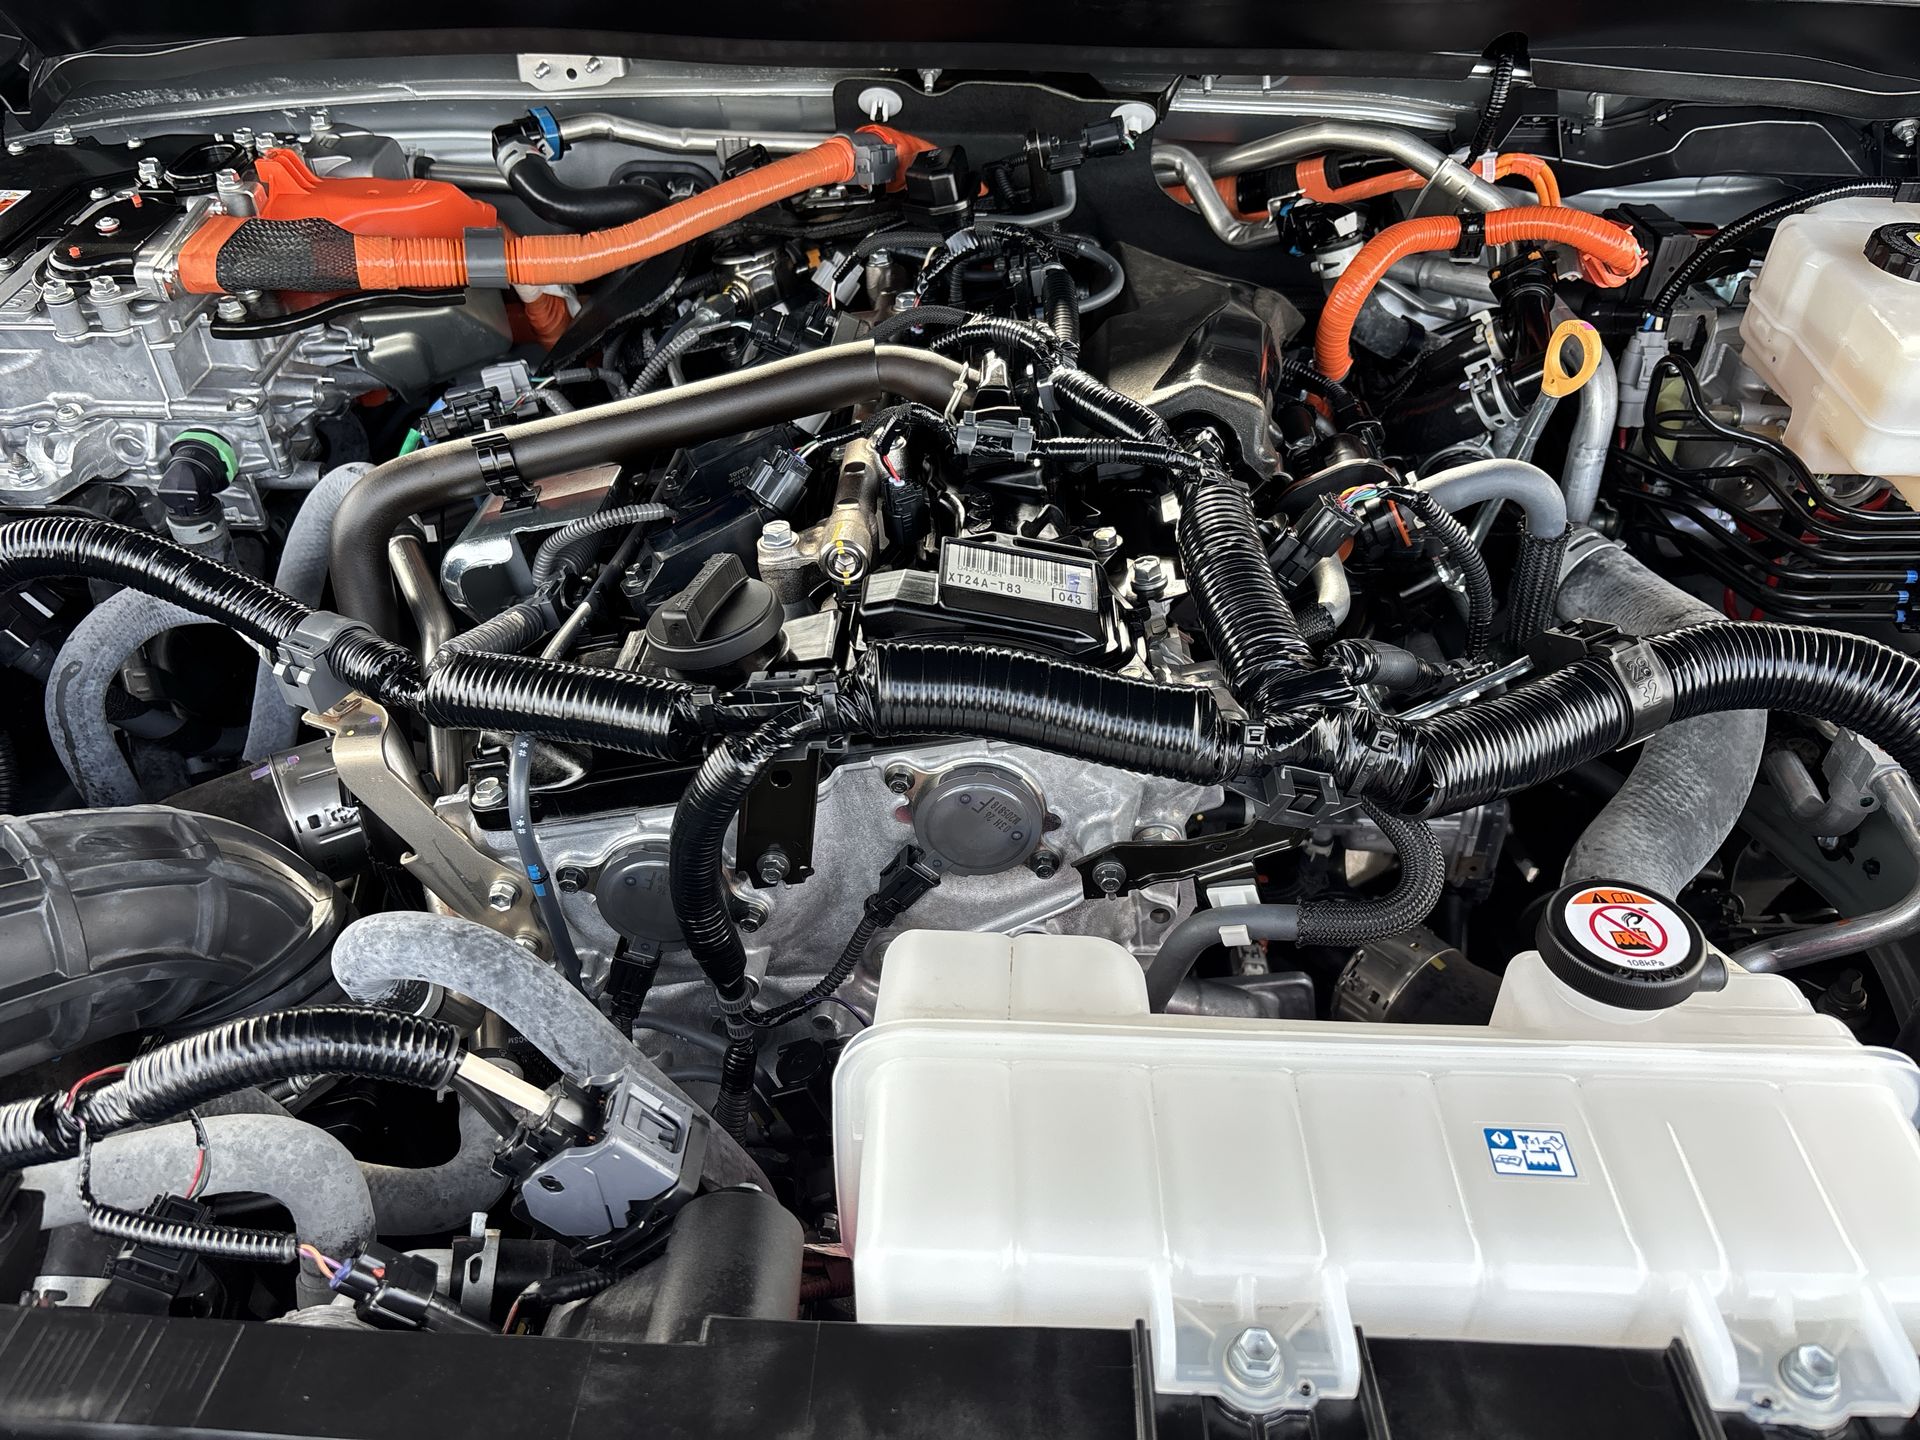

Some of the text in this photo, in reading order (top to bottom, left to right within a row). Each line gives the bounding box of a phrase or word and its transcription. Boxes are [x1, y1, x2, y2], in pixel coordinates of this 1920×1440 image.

[948, 572, 1022, 595] XT24A-T83
[1058, 592, 1082, 605] 043
[1636, 679, 1663, 708] 32
[971, 796, 995, 814] F
[1626, 959, 1665, 967] 108kPa
